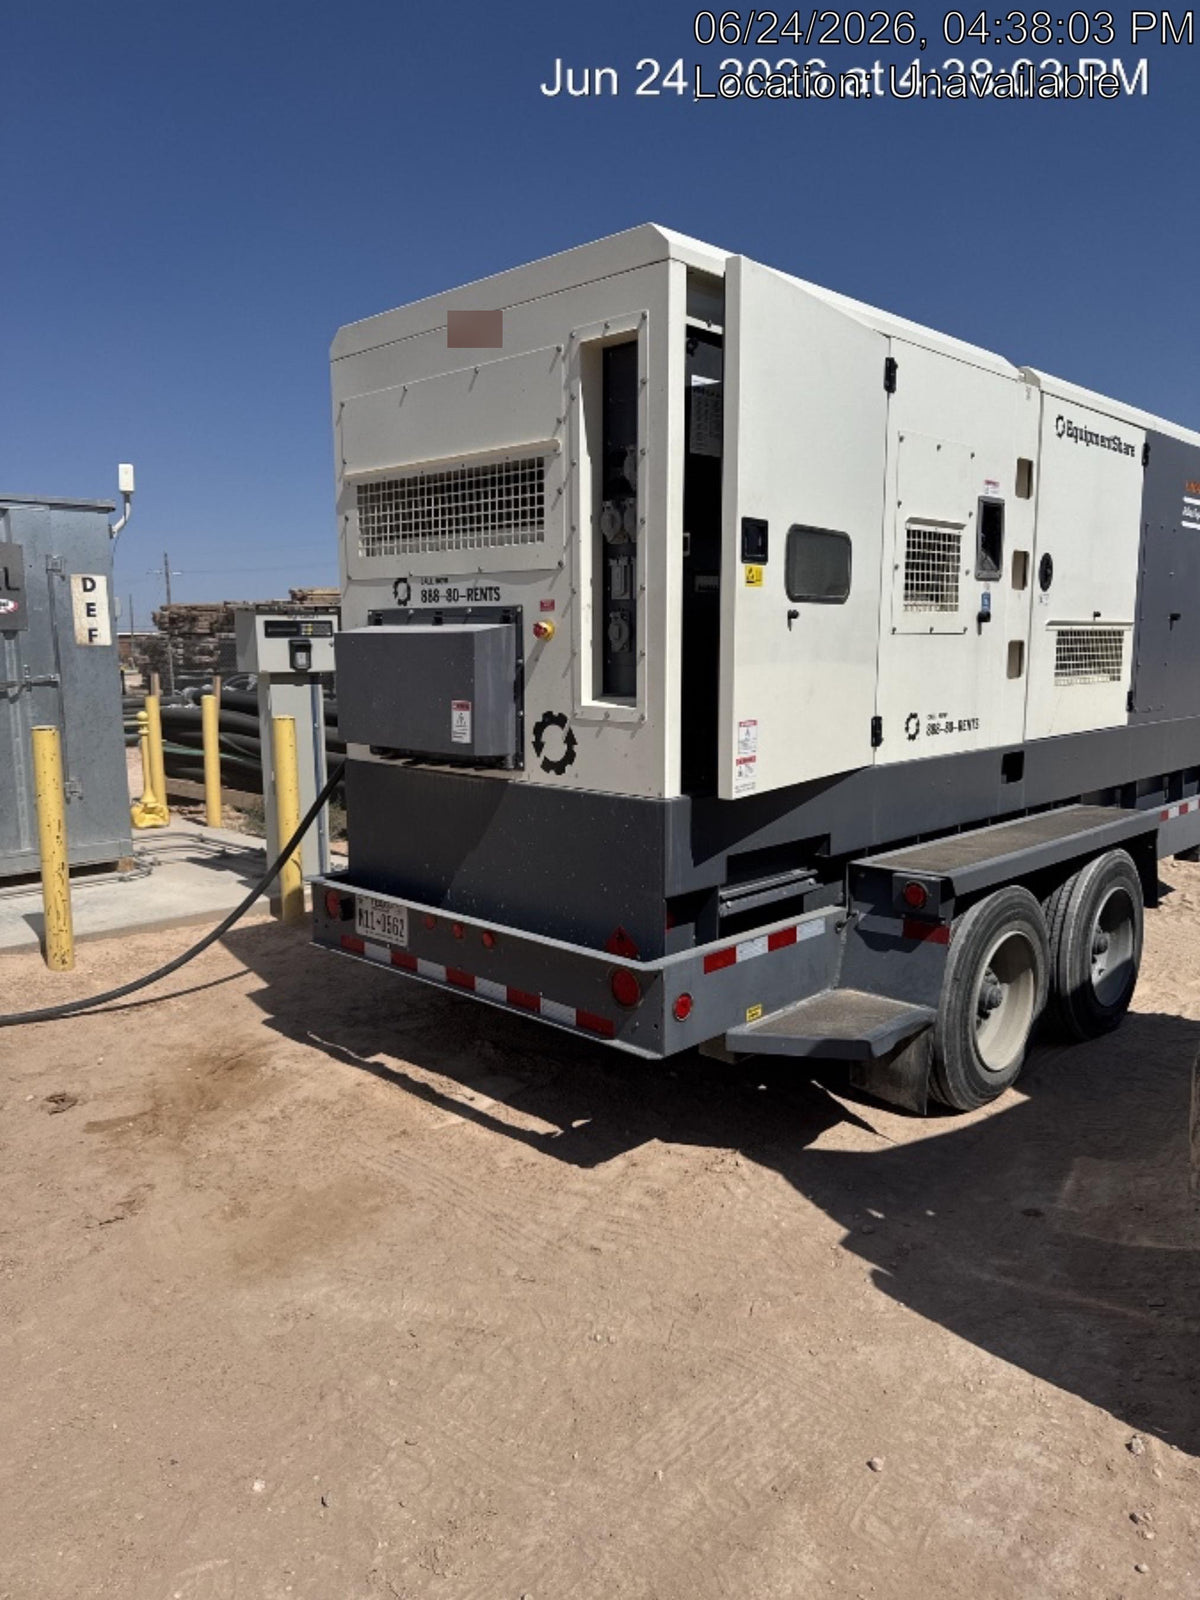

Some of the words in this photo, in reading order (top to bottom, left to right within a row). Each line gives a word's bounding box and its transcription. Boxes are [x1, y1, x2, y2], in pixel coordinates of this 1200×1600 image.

[1066, 418, 1136, 458] EquipmentShare
[0, 566, 20, 591] L
[420, 586, 501, 603] 888-80-RENTS
